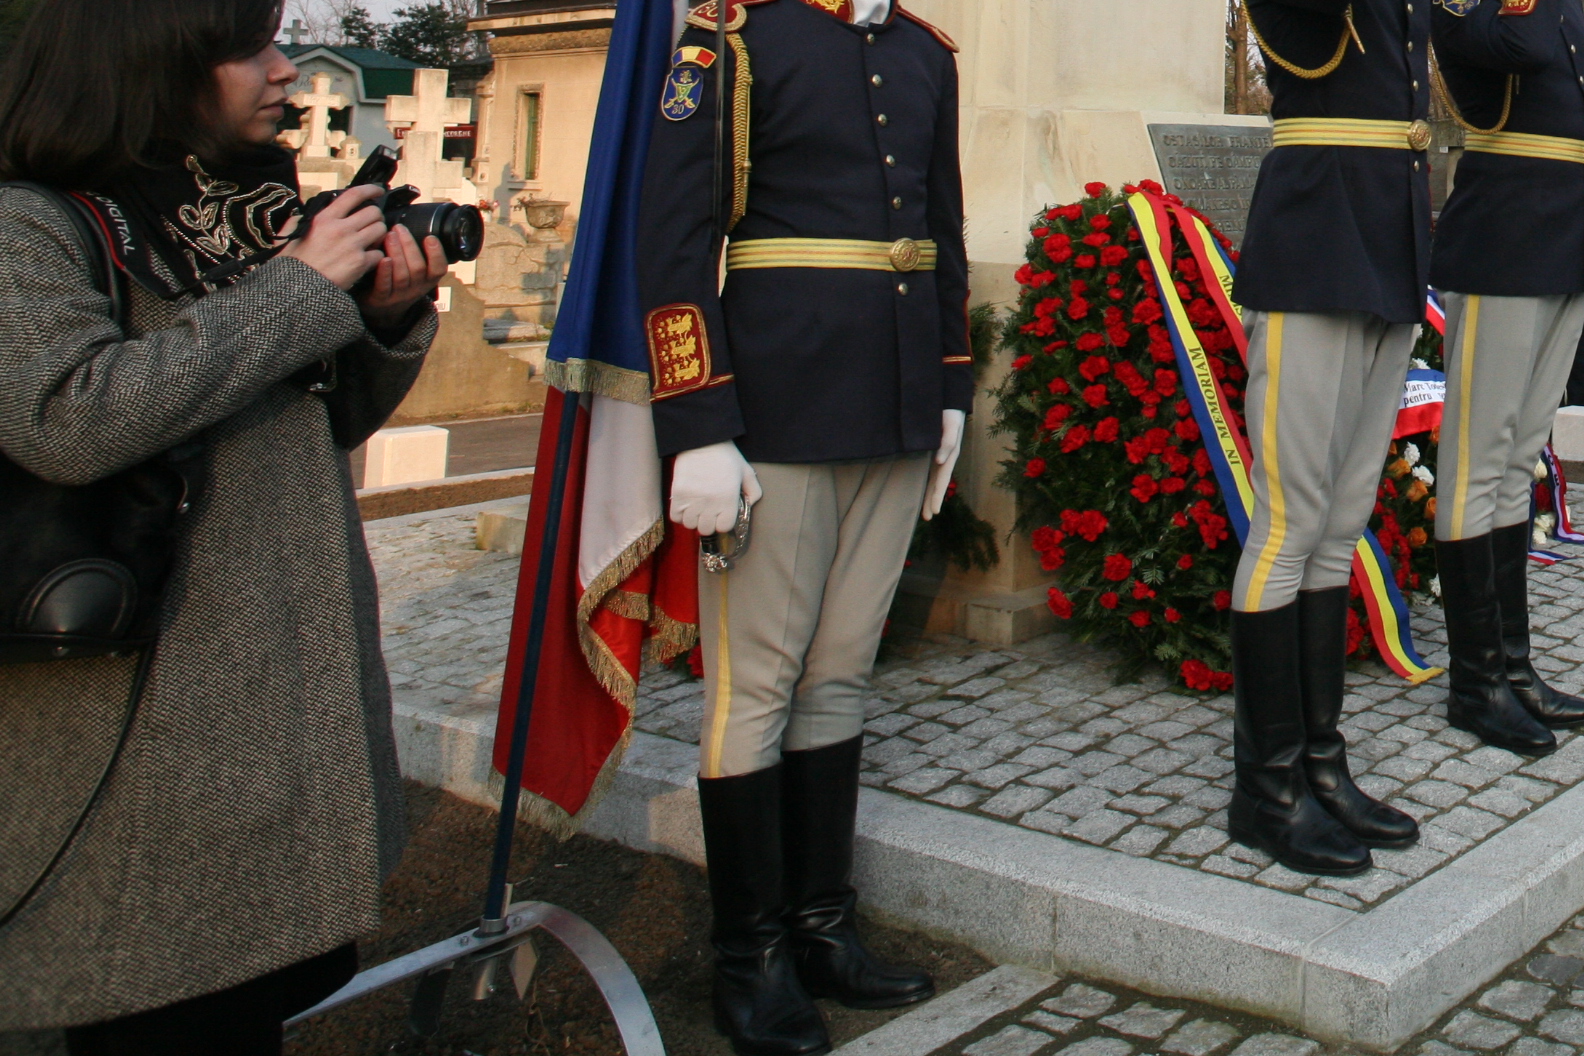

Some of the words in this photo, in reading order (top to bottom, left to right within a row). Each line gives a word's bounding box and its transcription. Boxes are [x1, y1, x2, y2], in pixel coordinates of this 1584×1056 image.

[671, 104, 685, 115] 30
[94, 195, 136, 256] DIGITAL
[1188, 346, 1231, 440] MEMORIAM
[1403, 392, 1434, 408] pentru
[1225, 448, 1241, 466] IN
